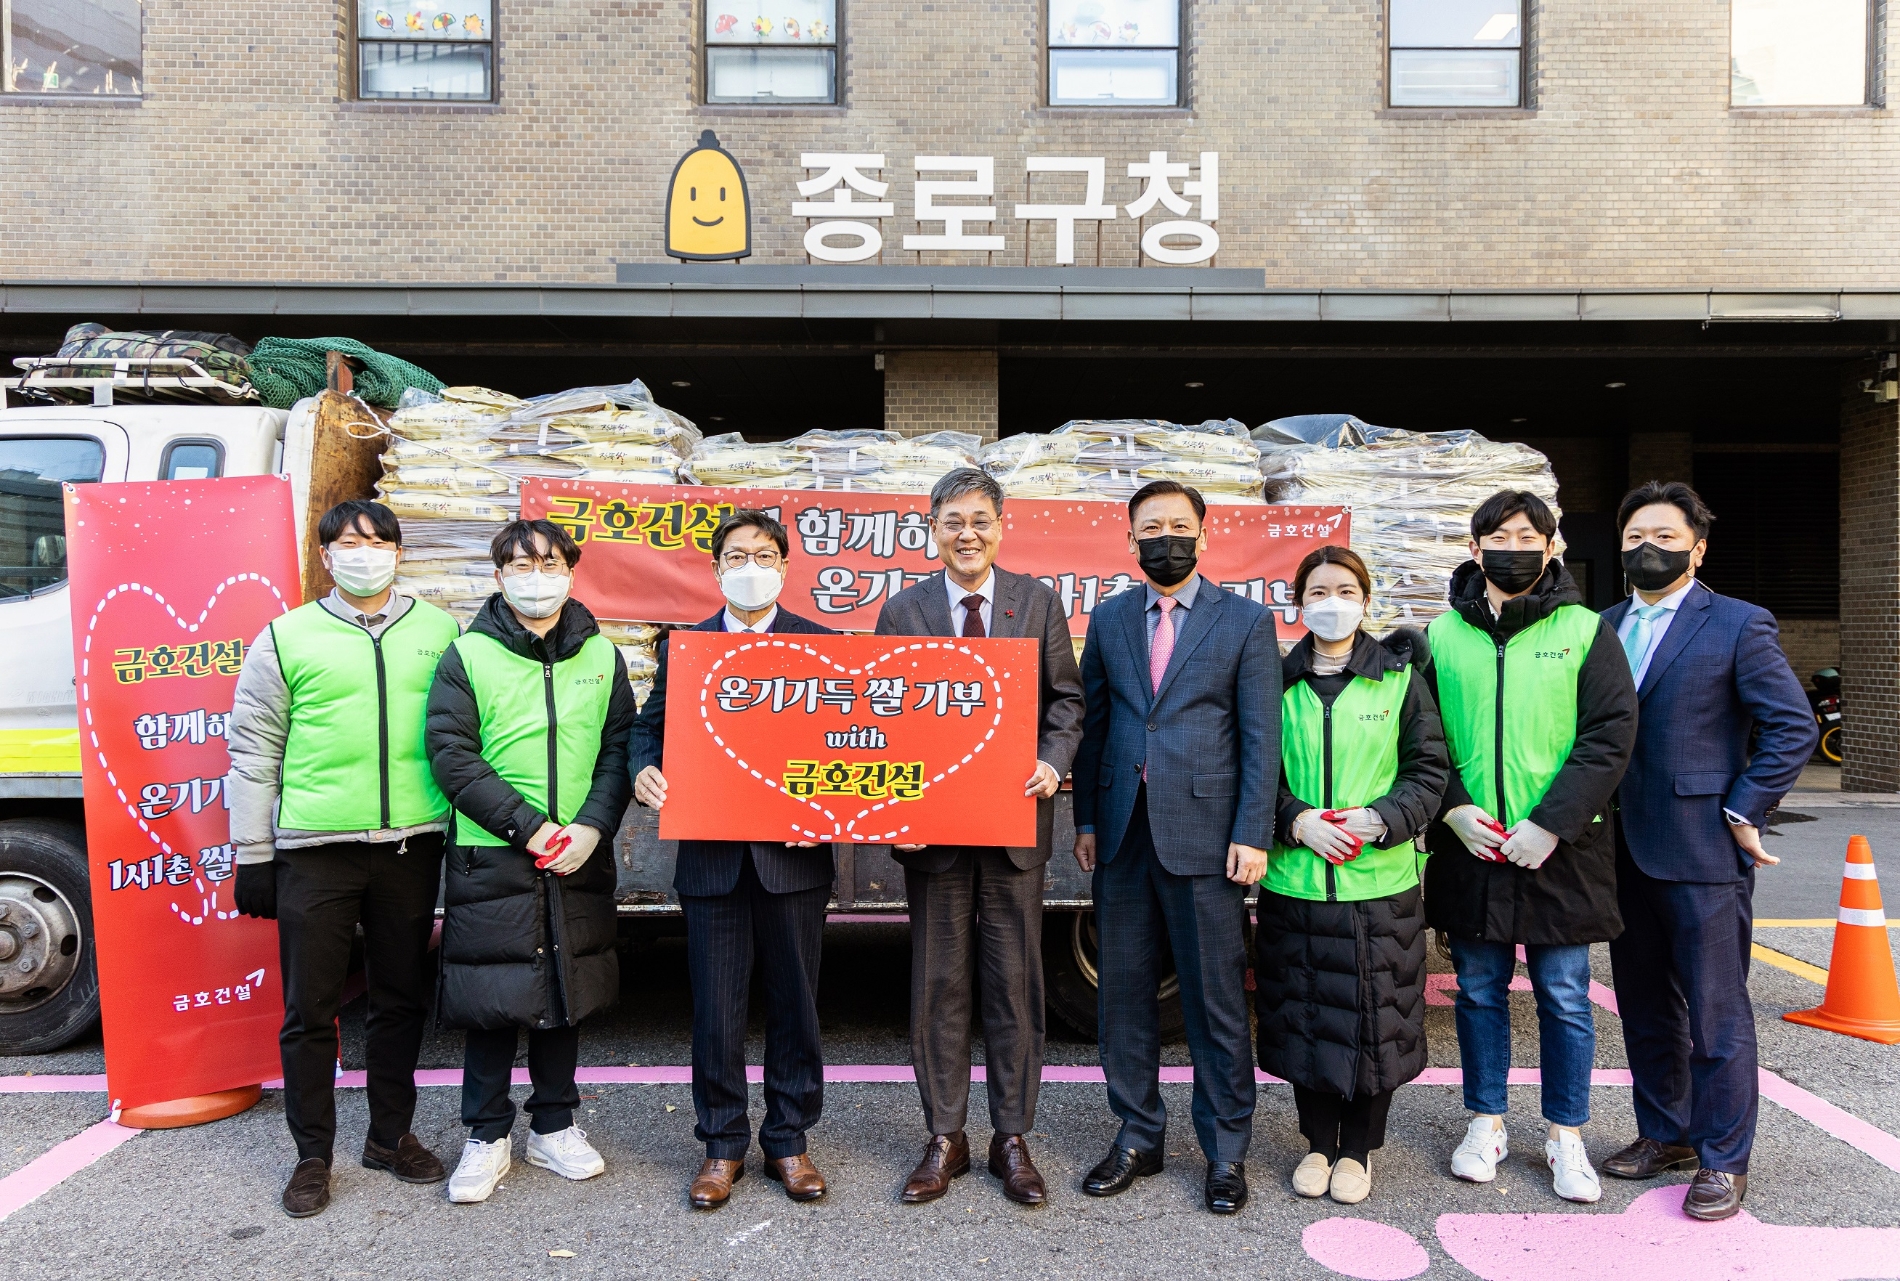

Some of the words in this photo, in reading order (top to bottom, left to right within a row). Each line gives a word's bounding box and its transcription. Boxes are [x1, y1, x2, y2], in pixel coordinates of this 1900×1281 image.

[792, 151, 1220, 264] 종로구청
[546, 496, 787, 555] 금호건설
[1267, 523, 1331, 538] 금호건설
[811, 566, 941, 614] 온기
[112, 638, 251, 685] 금호건설
[1534, 651, 1564, 659] 금호건설
[714, 675, 857, 715] 온기가득
[863, 675, 909, 717] 쌀
[912, 679, 986, 717] 기부
[1358, 713, 1385, 721] 금호건설
[825, 723, 889, 750] with
[782, 758, 926, 801] 금호건설
[108, 853, 194, 892] 1사1촌
[197, 842, 238, 883] 쌀
[173, 982, 251, 1012] 금호건설
